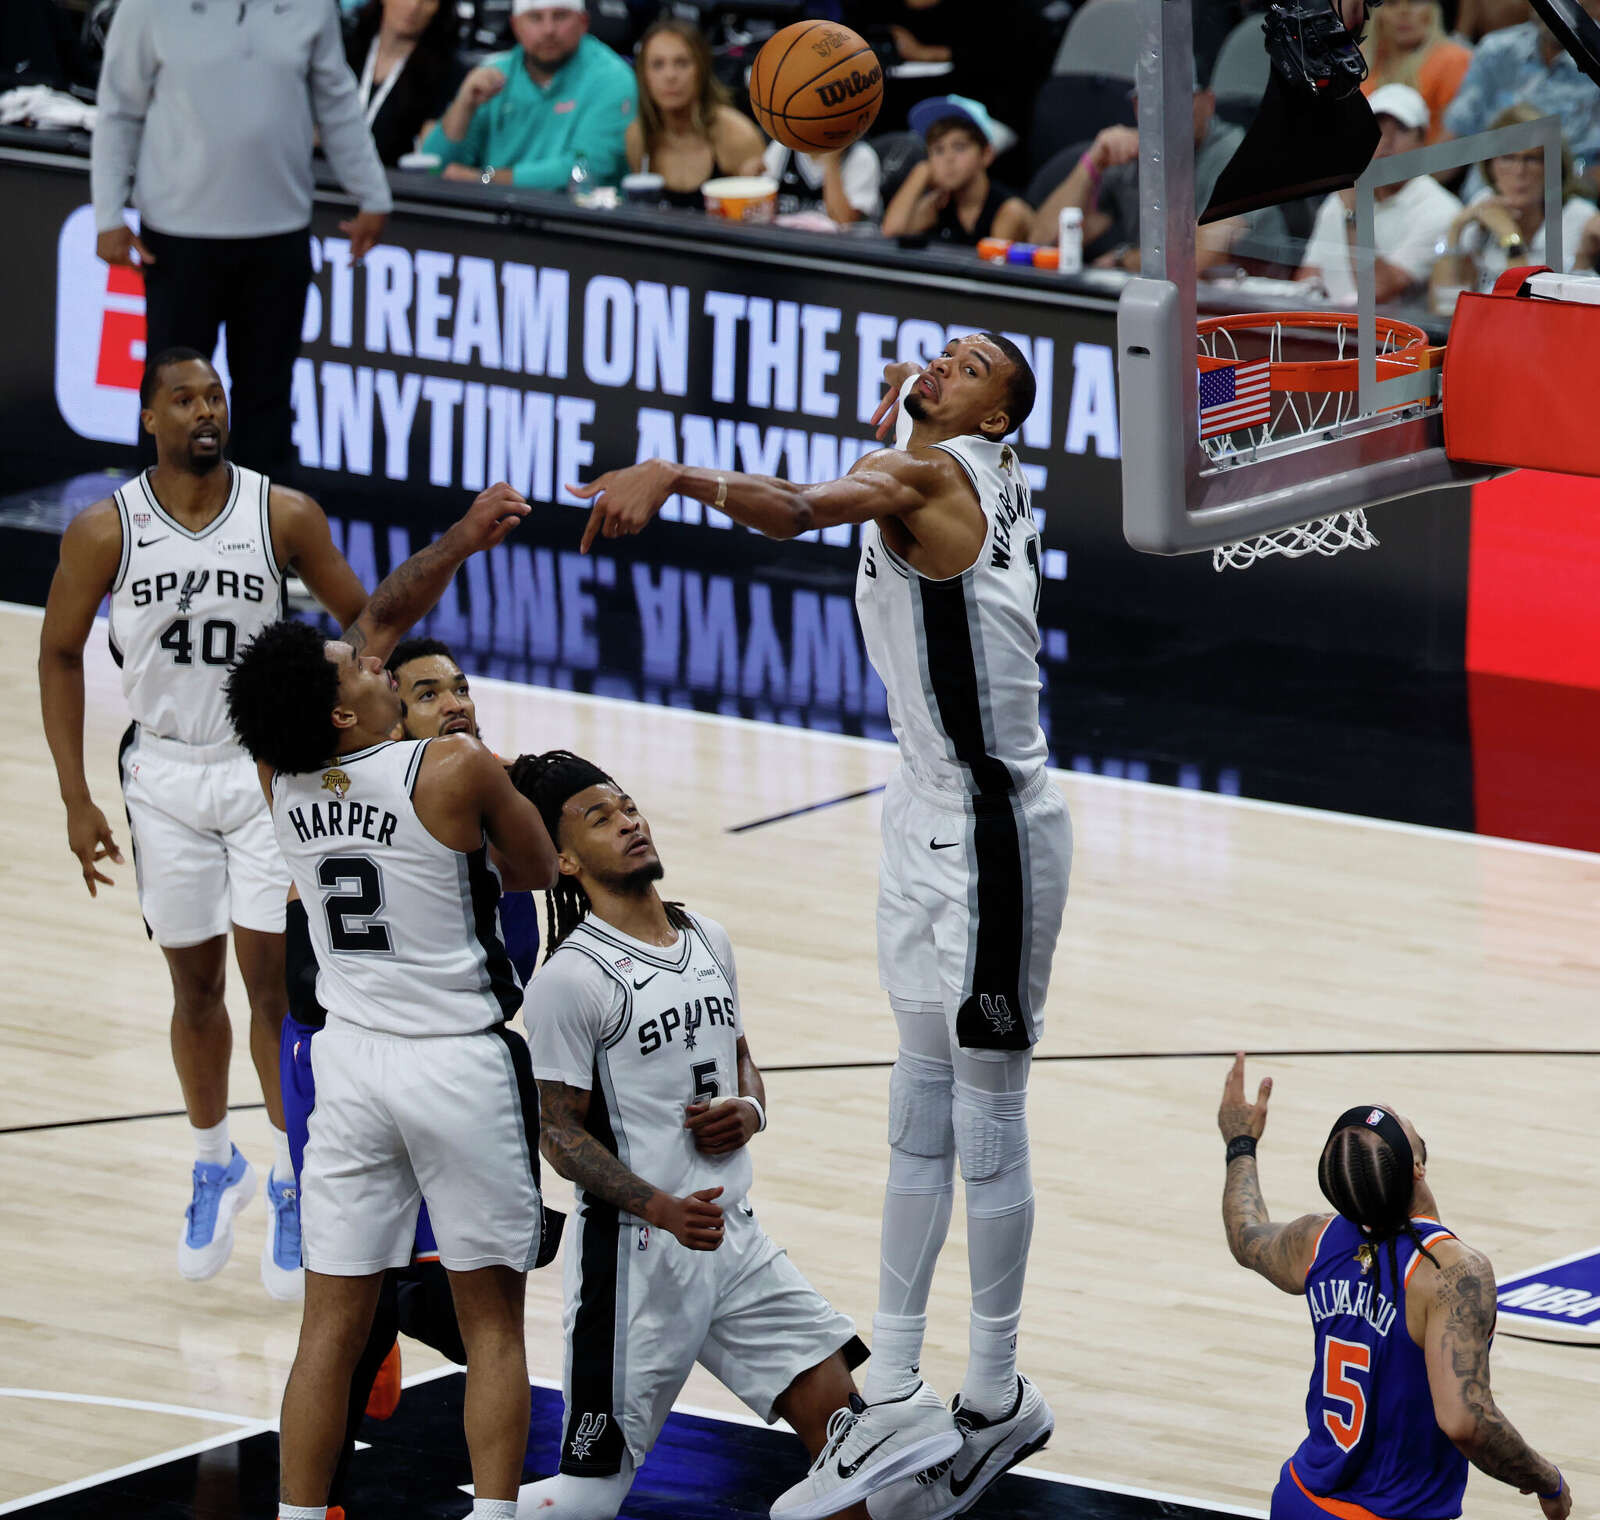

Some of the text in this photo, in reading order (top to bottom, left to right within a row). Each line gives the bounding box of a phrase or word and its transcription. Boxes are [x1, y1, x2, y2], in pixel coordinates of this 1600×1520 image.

[583, 274, 690, 397] ON
[703, 290, 842, 419] THE
[132, 569, 264, 614] SPURS
[159, 619, 237, 666] 40
[288, 801, 398, 847] HARPER
[315, 853, 395, 955] 2
[615, 957, 632, 967] USA
[697, 968, 716, 977] LEDGER
[638, 996, 736, 1055] SPURS
[690, 1058, 720, 1105] 5
[1323, 1335, 1370, 1453] 5
